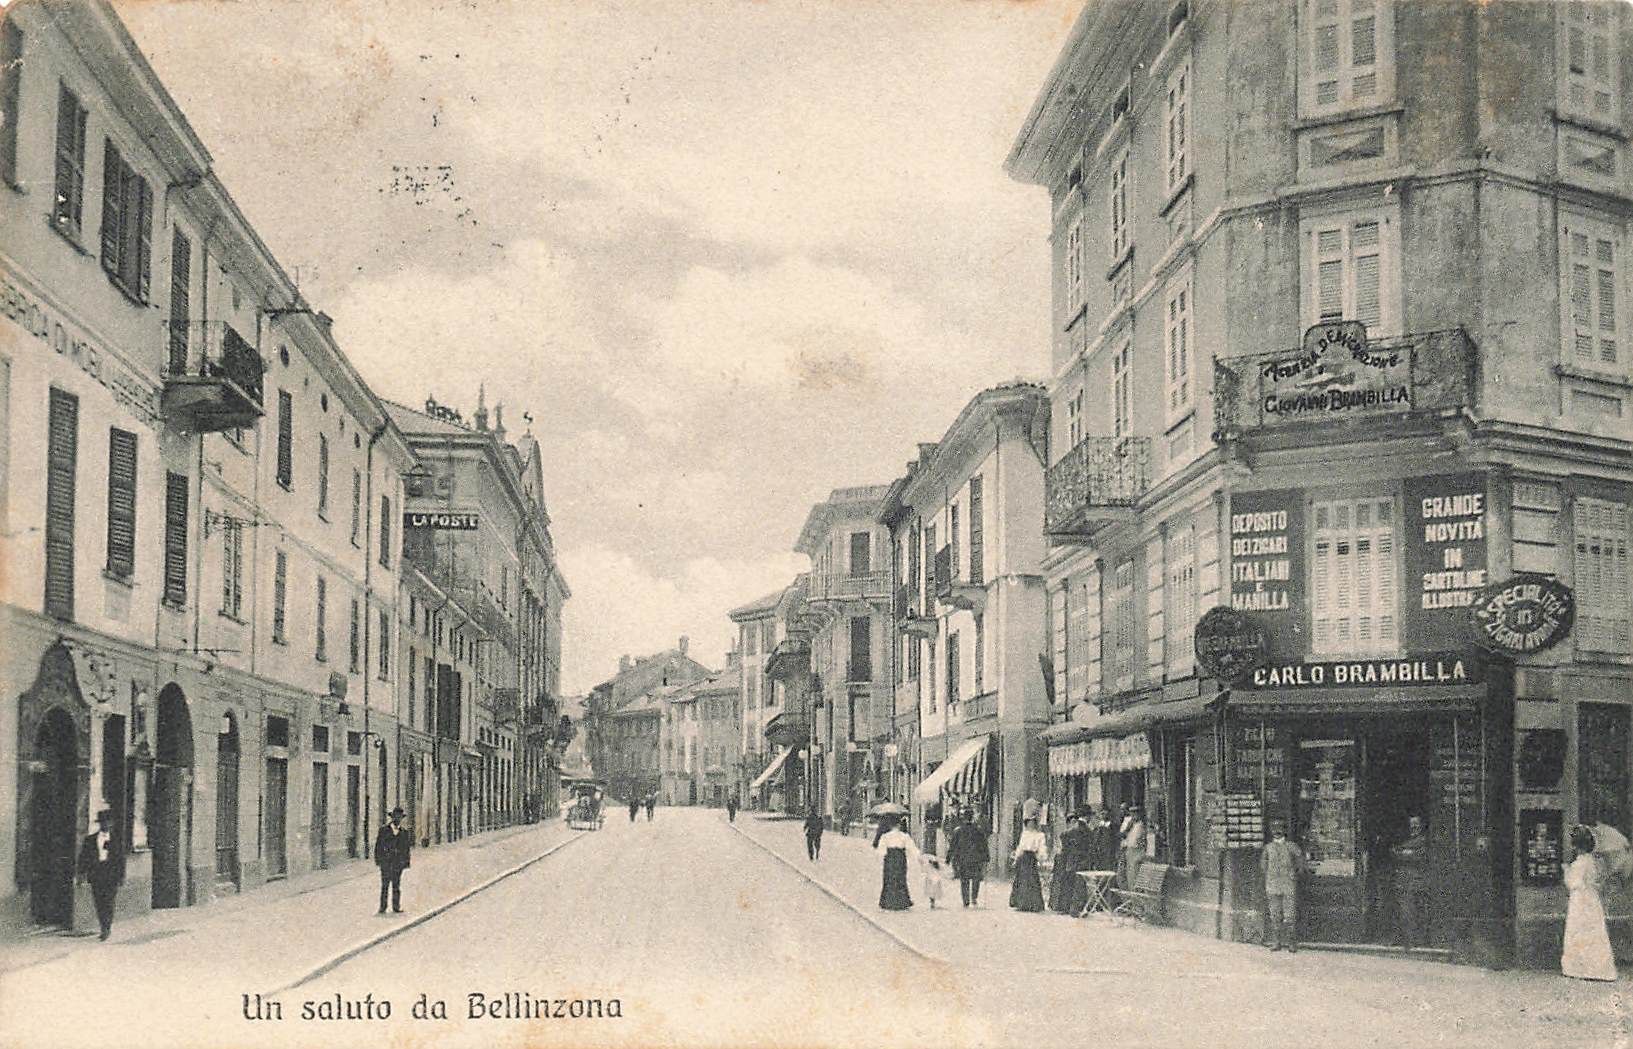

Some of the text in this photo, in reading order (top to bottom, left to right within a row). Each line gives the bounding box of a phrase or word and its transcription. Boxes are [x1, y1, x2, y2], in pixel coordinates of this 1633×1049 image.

[1423, 494, 1483, 518] GRANDE
[1232, 511, 1287, 533] DEPOSITO
[1444, 548, 1461, 568] IN
[1233, 560, 1289, 582] ITALIANI
[1232, 591, 1289, 611] MANILLA
[1254, 660, 1466, 686] CARLO BRAMBILLA
